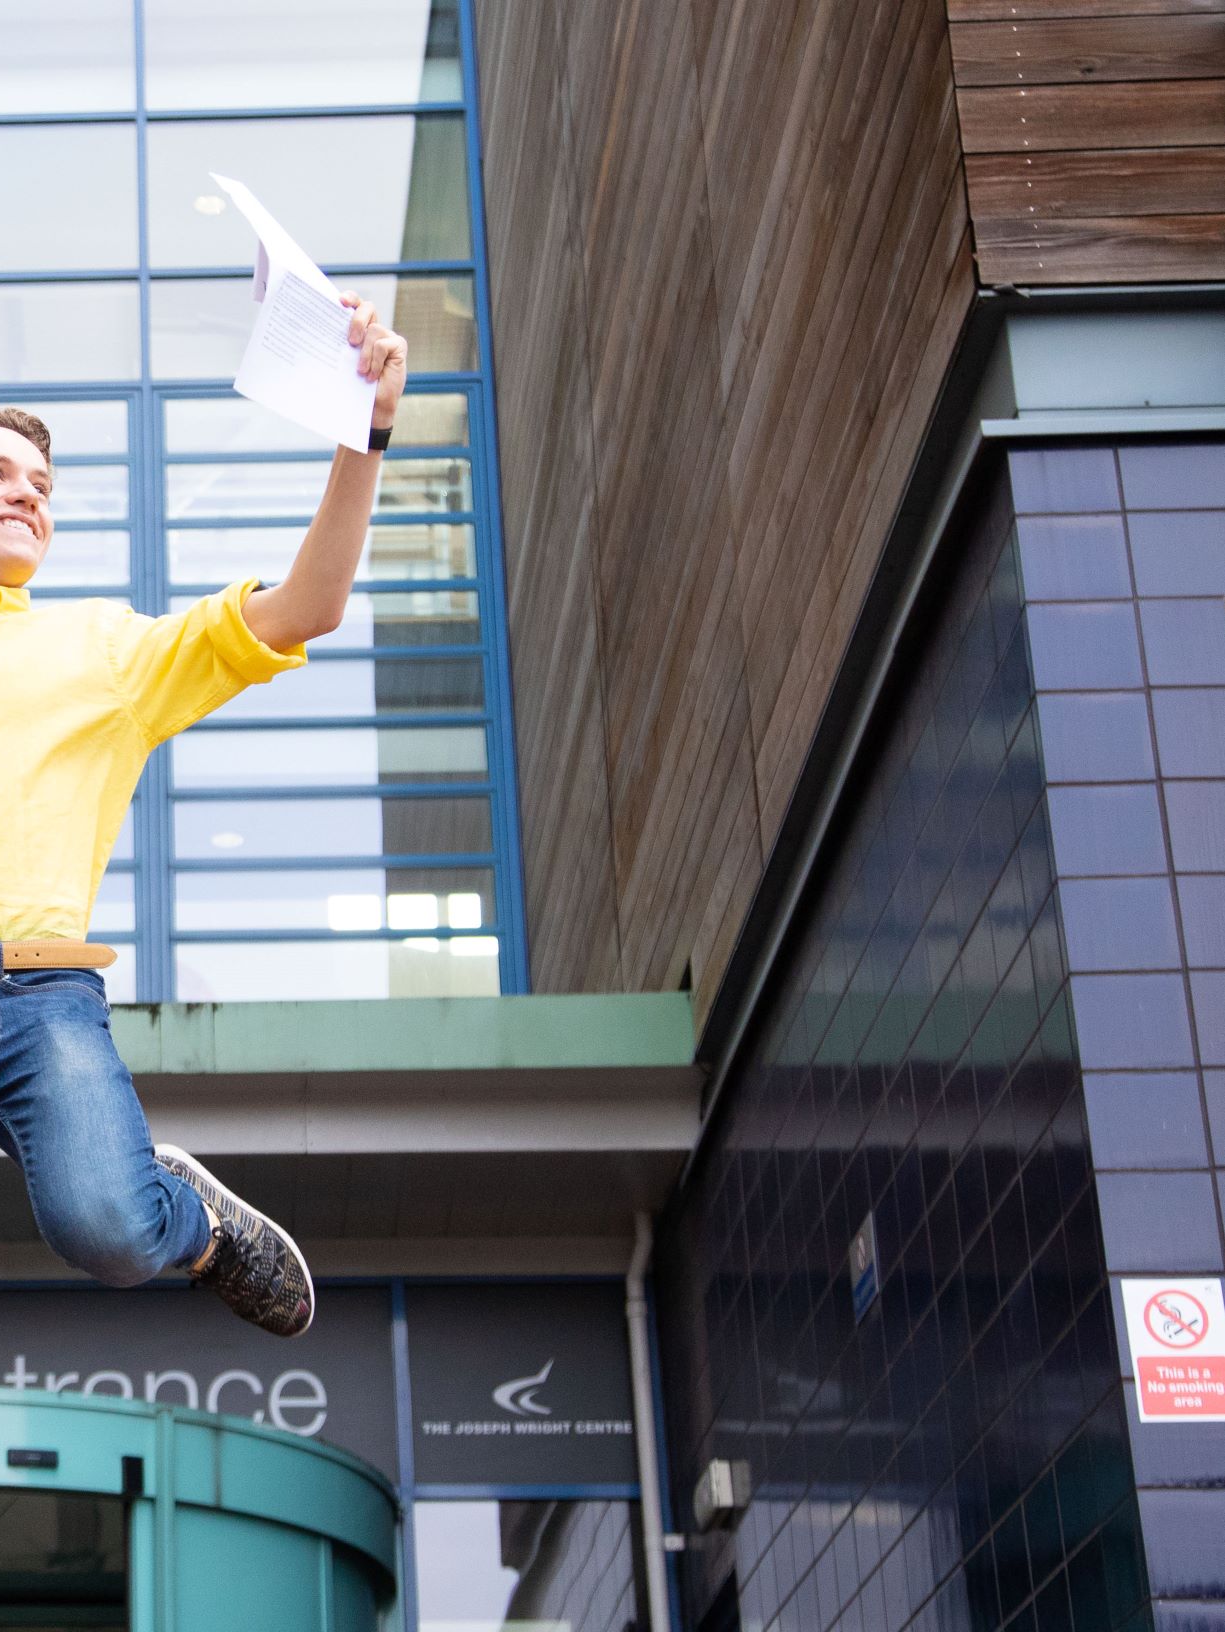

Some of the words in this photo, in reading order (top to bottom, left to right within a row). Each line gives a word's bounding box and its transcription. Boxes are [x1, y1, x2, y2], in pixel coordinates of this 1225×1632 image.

[1156, 1366, 1184, 1379] This
[1188, 1366, 1199, 1379] is
[1203, 1367, 1211, 1379] a
[1148, 1380, 1166, 1393] No
[1169, 1380, 1225, 1395] smoking
[1174, 1396, 1203, 1408] area
[423, 1421, 451, 1435] THE
[455, 1421, 511, 1435] JOSEPH
[513, 1420, 571, 1434] WRIGHT
[575, 1420, 633, 1434] CENTRE
